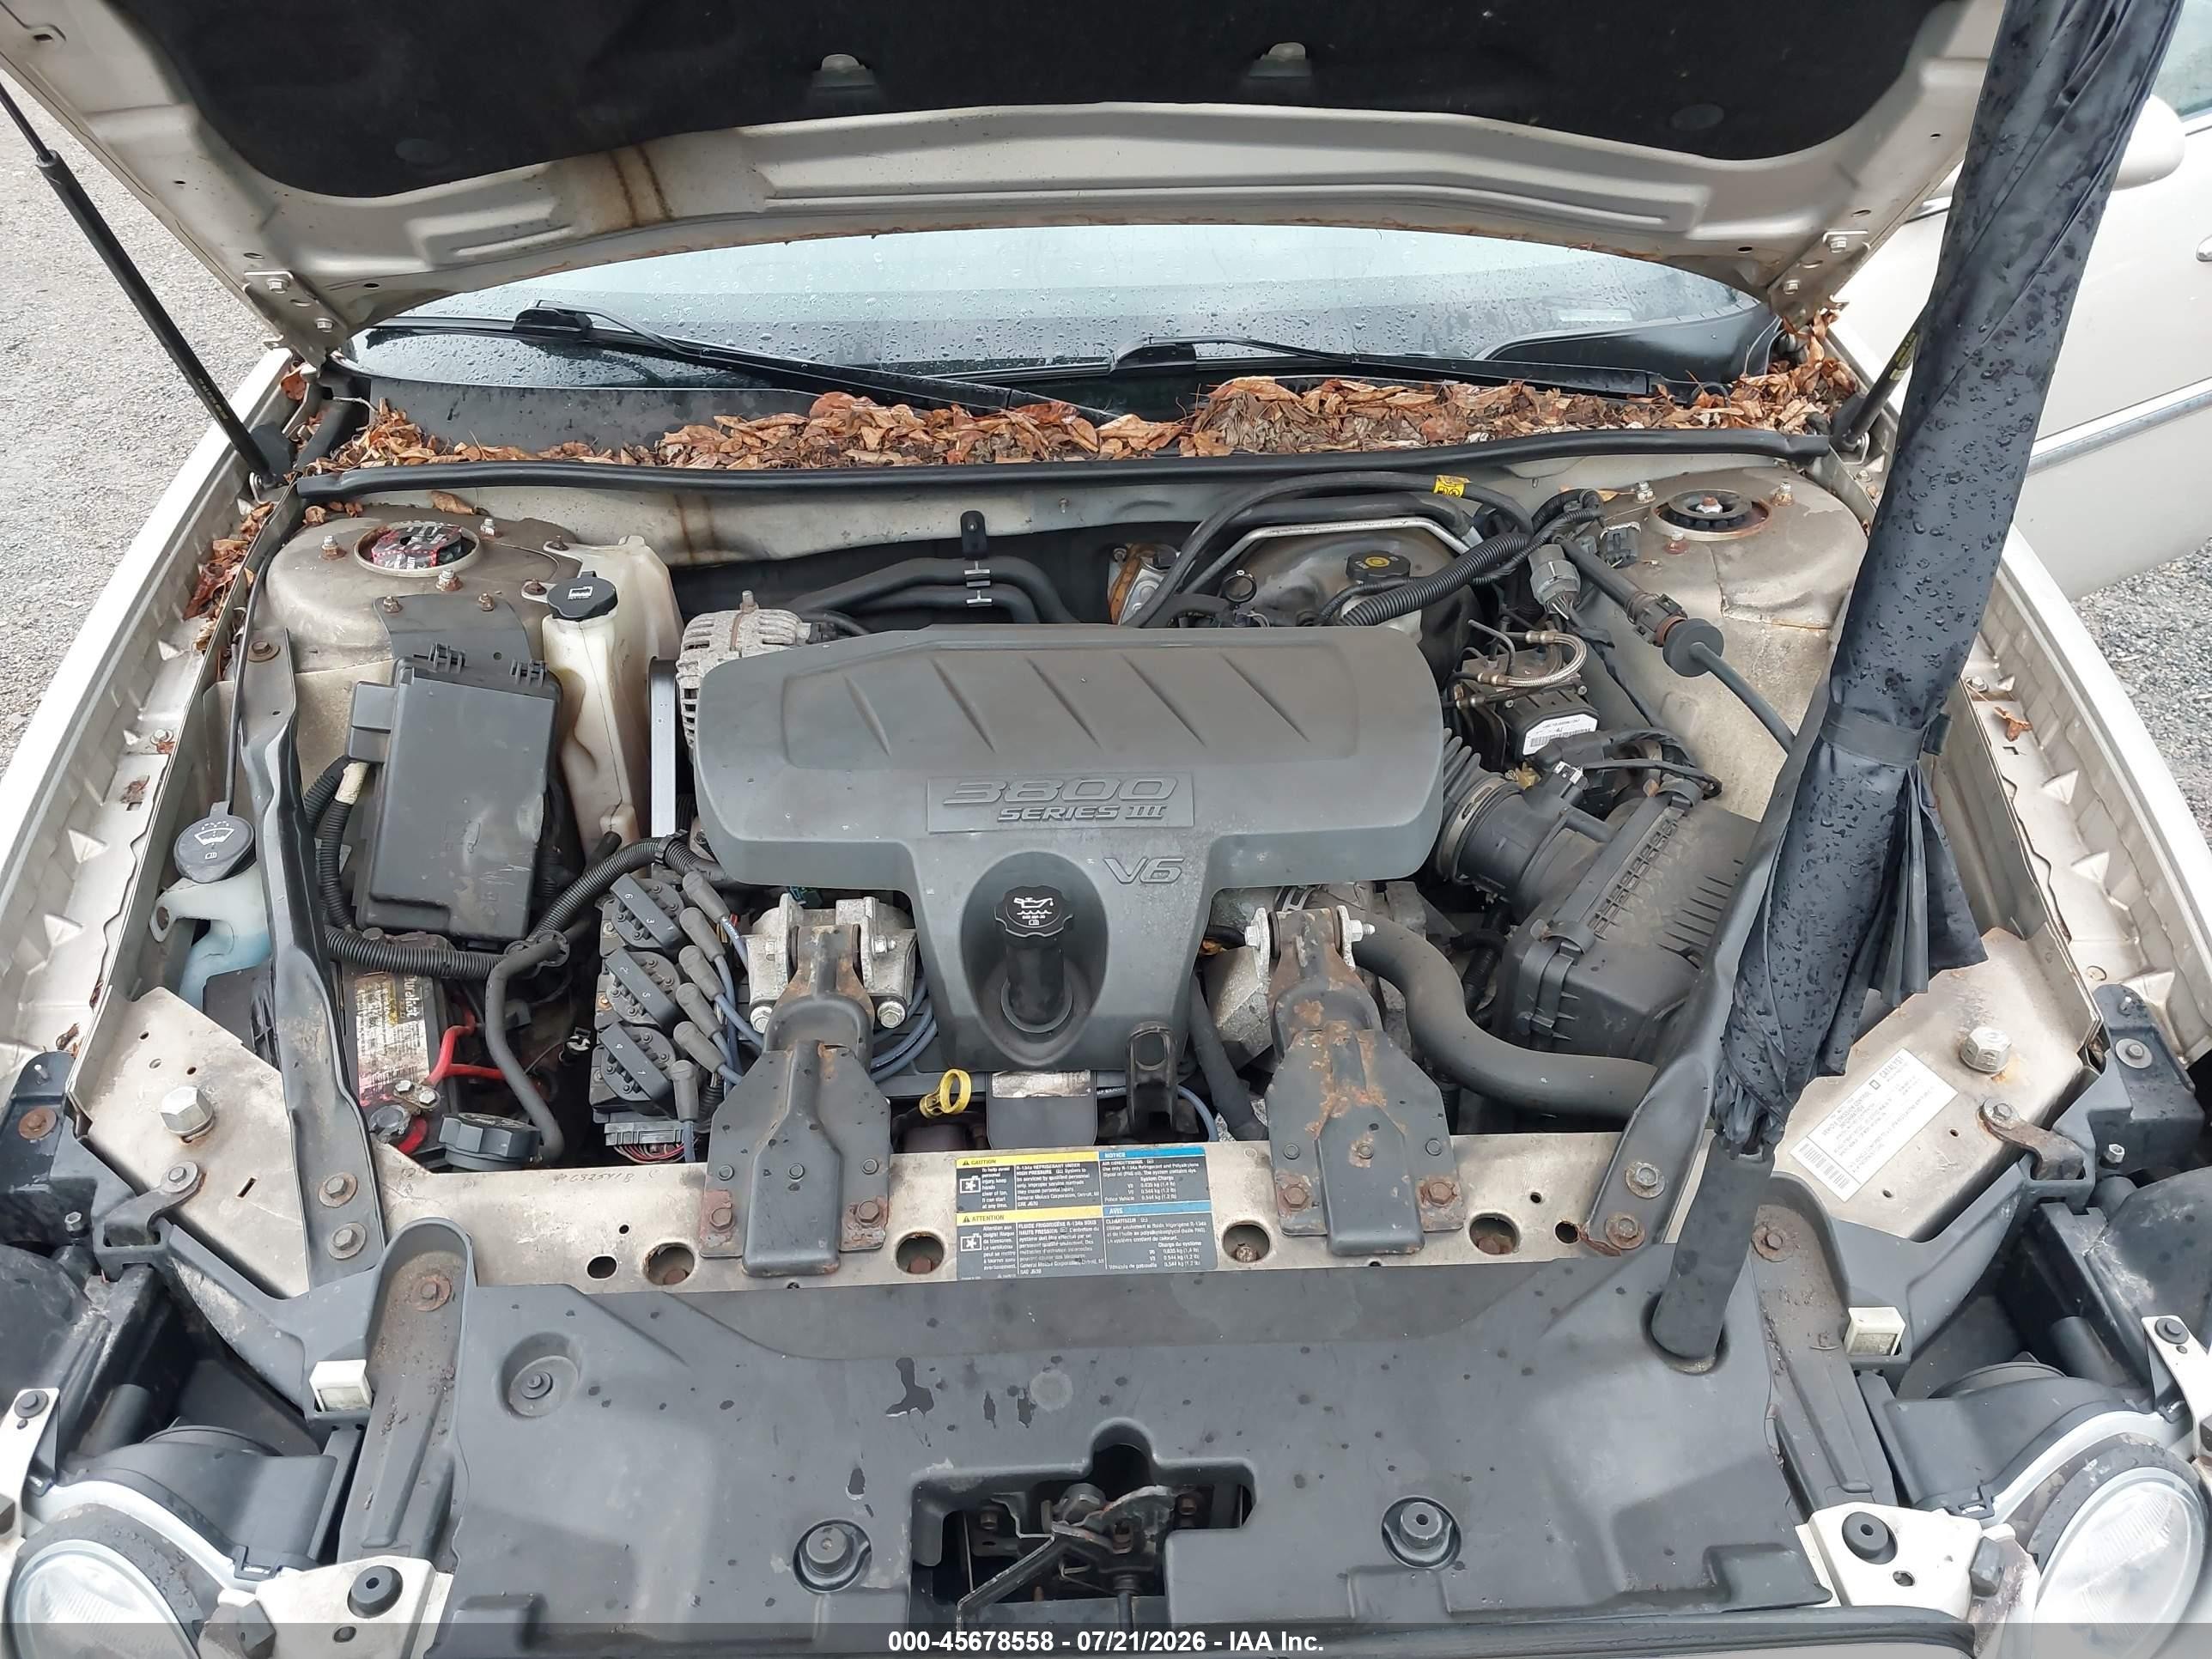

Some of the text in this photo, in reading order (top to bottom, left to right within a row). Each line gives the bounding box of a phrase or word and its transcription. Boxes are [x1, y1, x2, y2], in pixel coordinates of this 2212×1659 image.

[943, 777, 1179, 805] 3800
[997, 805, 1167, 822] SERIES III
[1103, 858, 1185, 884] V6
